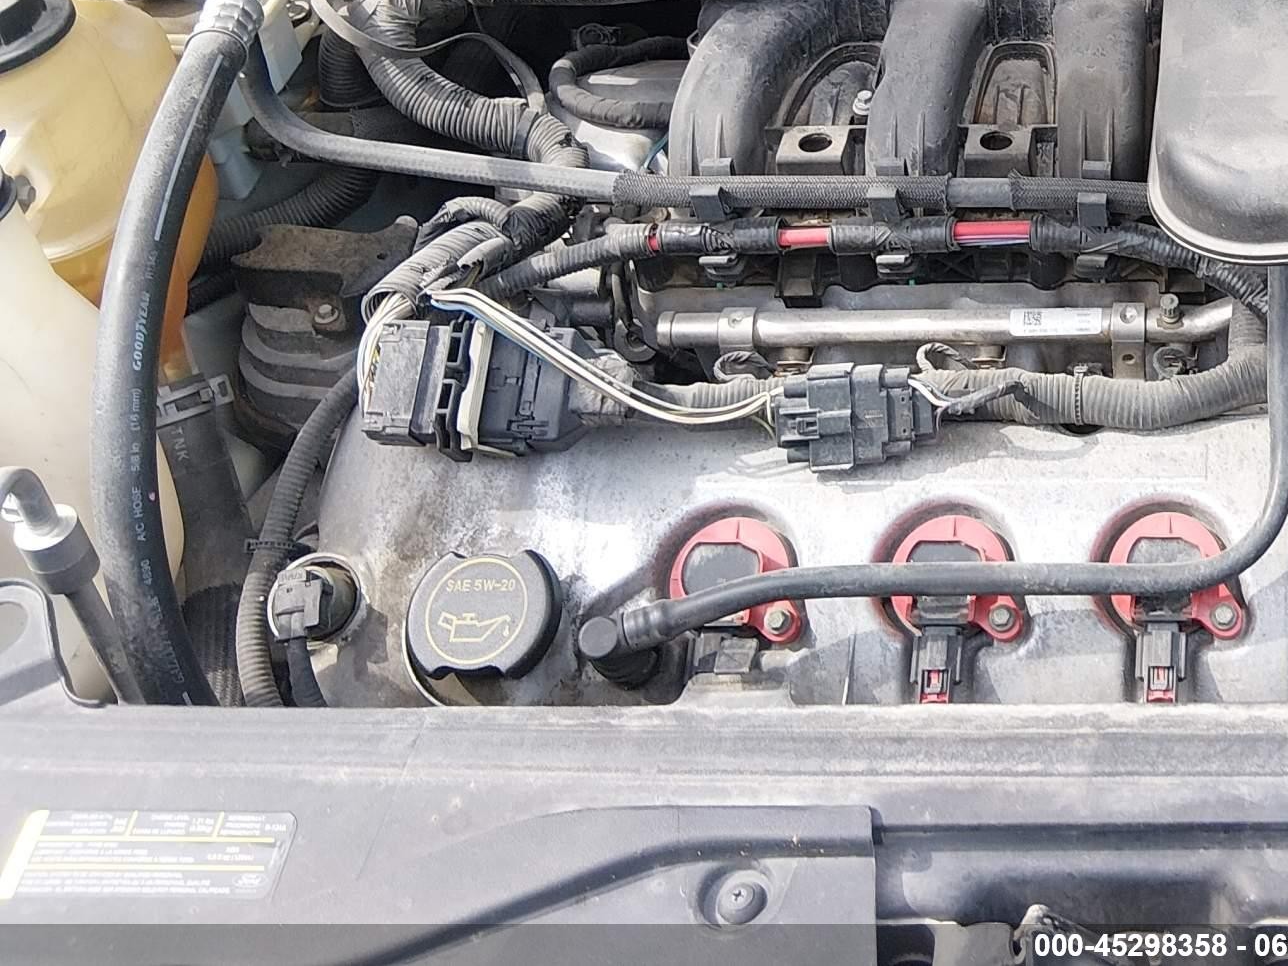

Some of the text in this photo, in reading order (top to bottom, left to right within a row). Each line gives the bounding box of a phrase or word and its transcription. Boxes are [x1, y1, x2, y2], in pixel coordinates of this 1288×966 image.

[132, 291, 151, 371] GOODYEAR
[132, 486, 144, 519] HOSE
[446, 578, 516, 592] SAE 5W-20
